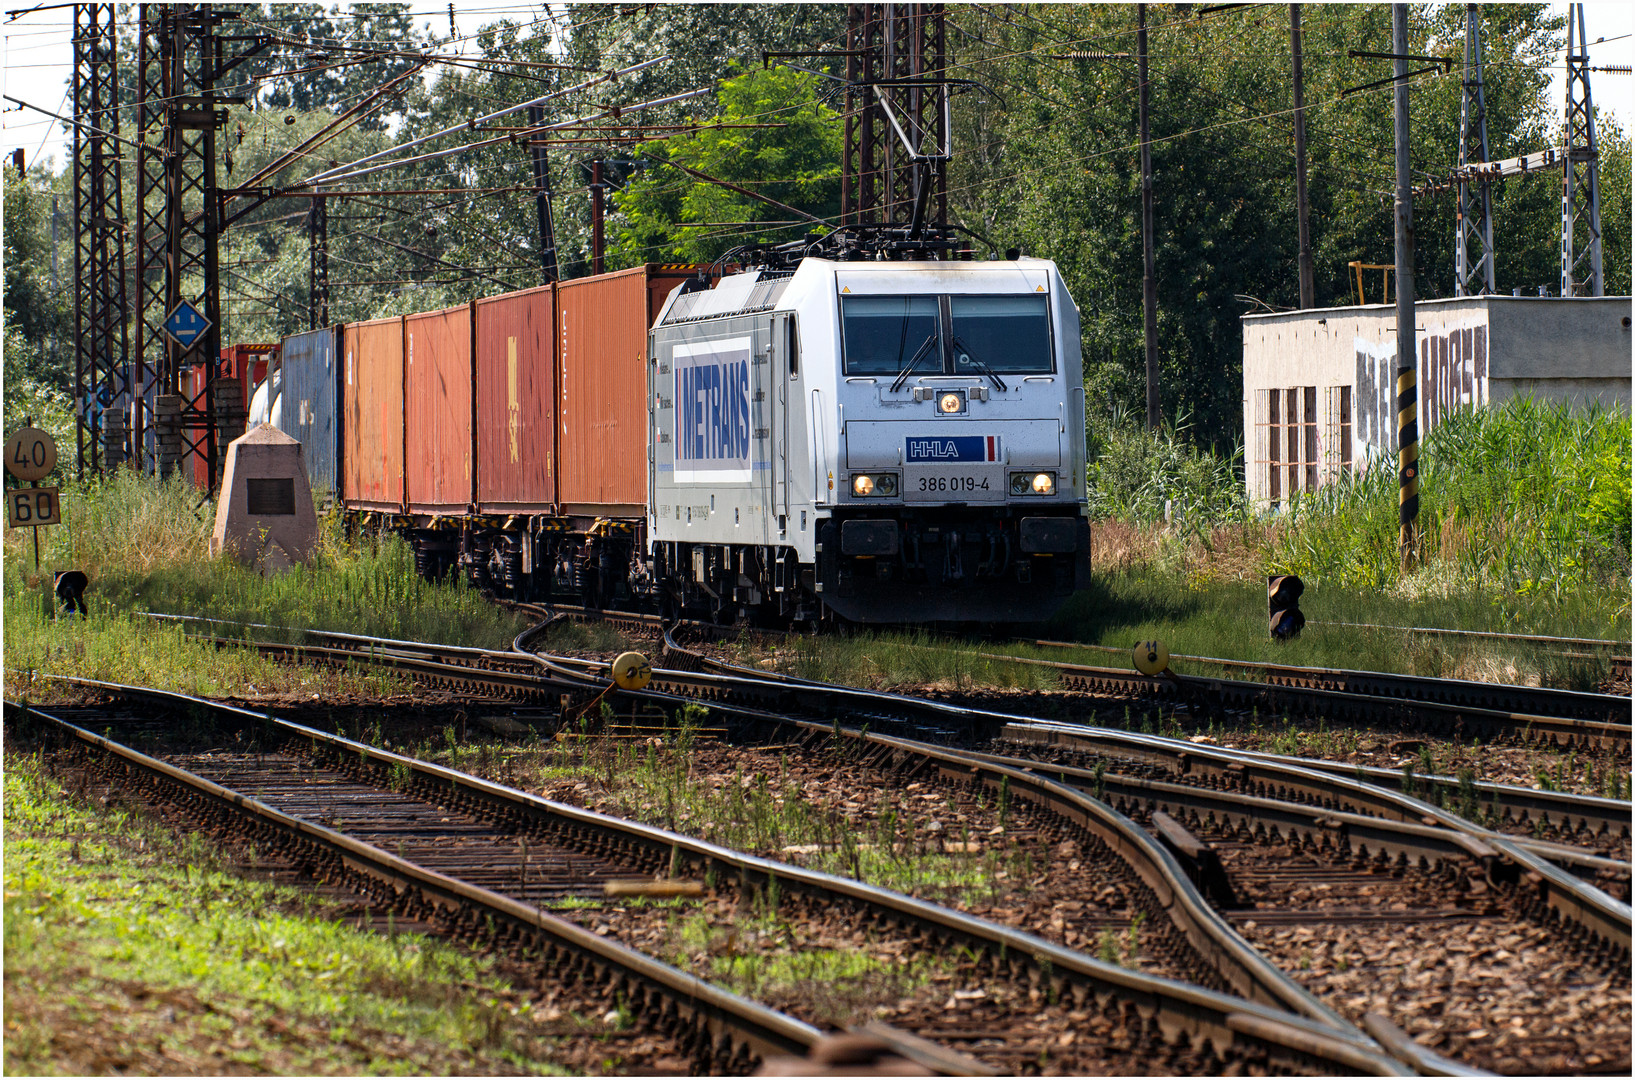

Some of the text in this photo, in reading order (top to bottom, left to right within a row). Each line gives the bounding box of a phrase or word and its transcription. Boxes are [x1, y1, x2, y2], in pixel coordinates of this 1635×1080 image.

[683, 359, 750, 460] METRANS
[14, 440, 46, 468] 40
[910, 440, 959, 458] HHLA
[919, 477, 989, 491] 386 019-4
[14, 492, 52, 521] 60
[1145, 640, 1157, 652] 11
[638, 662, 652, 679] 12
